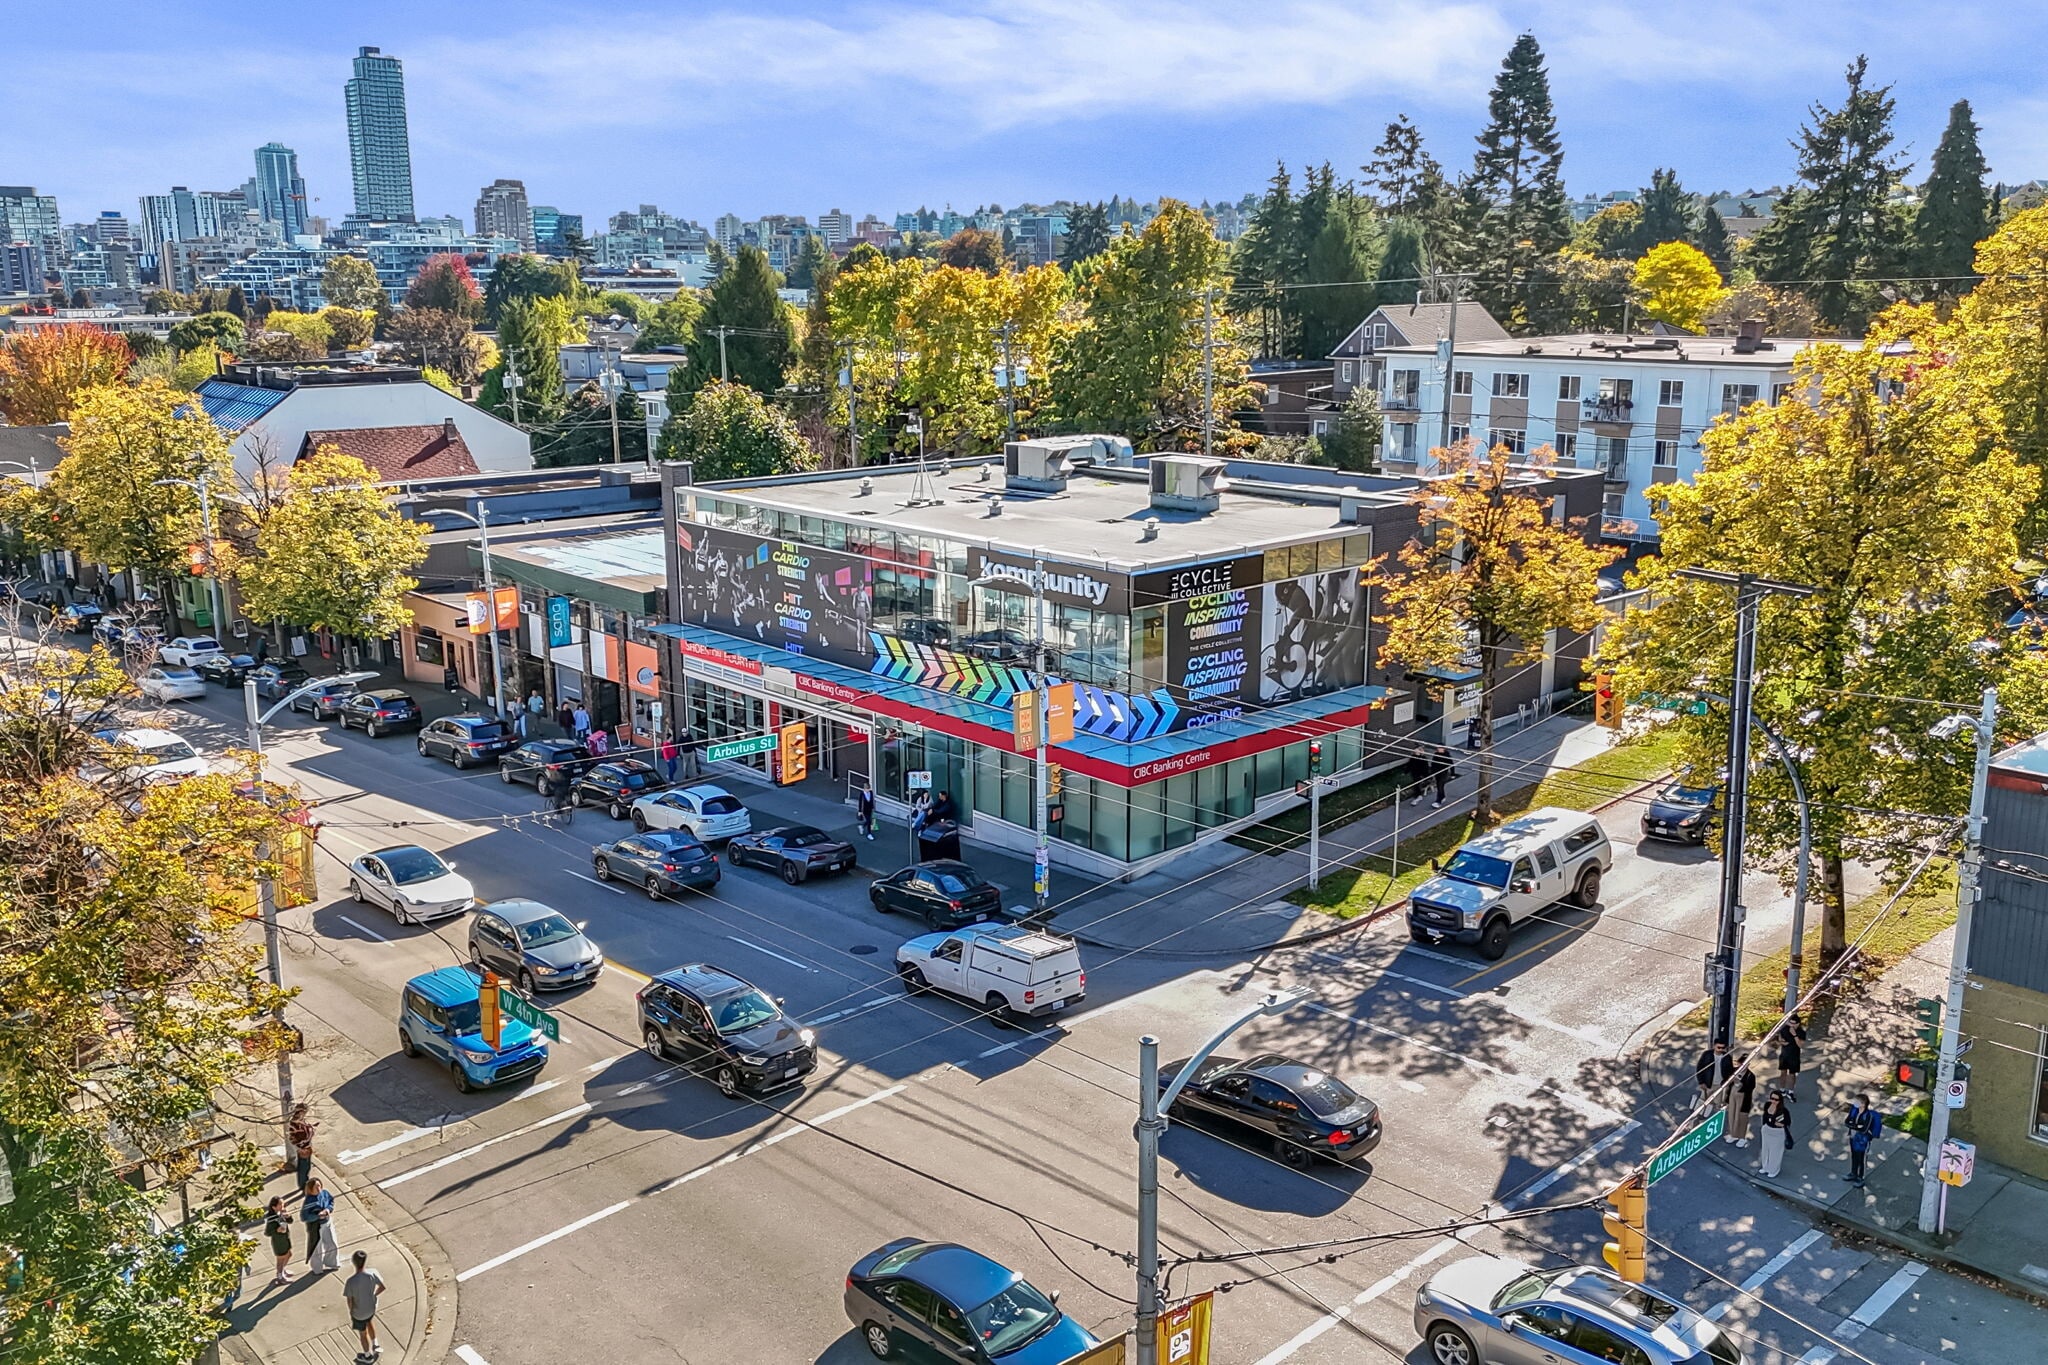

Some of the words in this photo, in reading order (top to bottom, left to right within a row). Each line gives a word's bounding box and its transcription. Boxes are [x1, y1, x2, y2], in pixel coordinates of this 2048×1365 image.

[772, 551, 810, 568] CARDIO
[1180, 565, 1232, 588] CYCLE
[1180, 582, 1232, 598] COLLECTIVE
[1189, 589, 1246, 610] CYCLING
[774, 602, 812, 620] CARDIO
[1184, 602, 1250, 626] INSPIRING
[1190, 618, 1243, 640] COMMUNITY
[1187, 648, 1244, 671] CYCLING
[1182, 661, 1248, 687] INSPIRING
[811, 679, 834, 696] Banking
[834, 686, 855, 700] Centre
[1188, 678, 1241, 701] COMMUNITY
[713, 743, 756, 759] Arbutus
[759, 737, 772, 749] St
[1133, 765, 1152, 779] CIBC
[1153, 759, 1184, 774] Banking
[1185, 752, 1211, 765] Centre
[503, 992, 513, 1011] W
[536, 1013, 554, 1036] Ave
[1653, 1134, 1702, 1178] Arbutus
[1705, 1119, 1719, 1140] St
